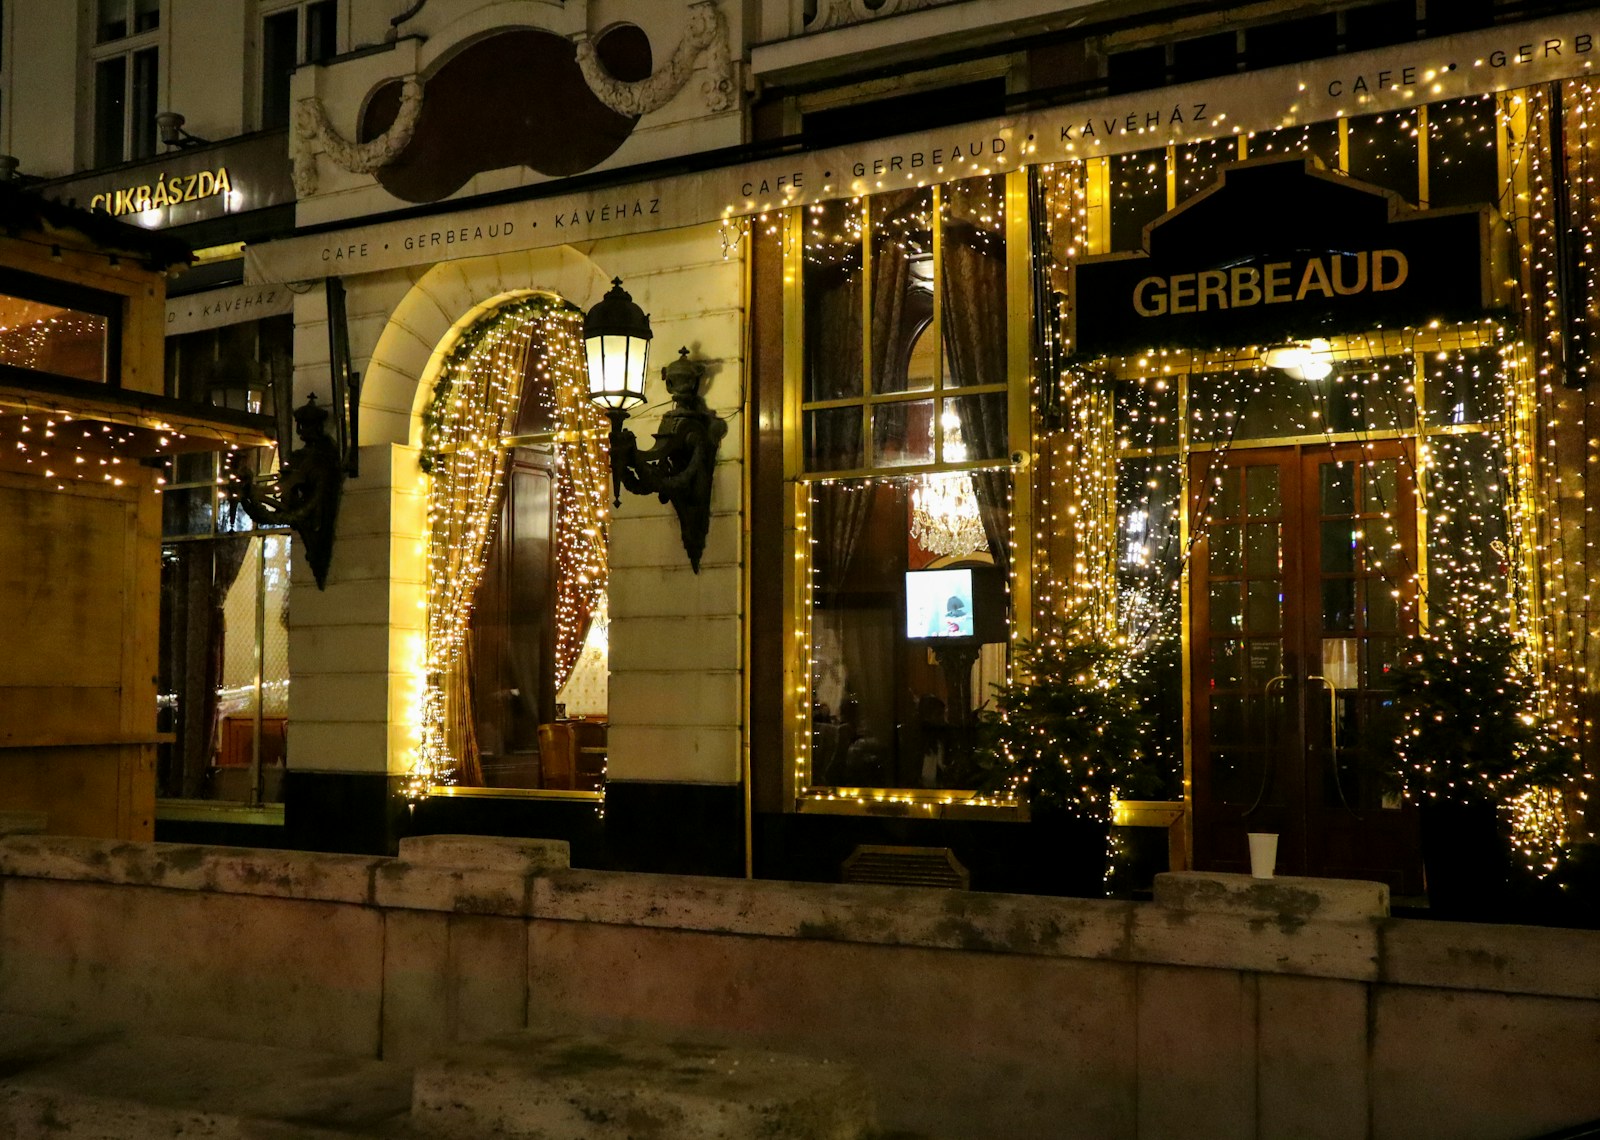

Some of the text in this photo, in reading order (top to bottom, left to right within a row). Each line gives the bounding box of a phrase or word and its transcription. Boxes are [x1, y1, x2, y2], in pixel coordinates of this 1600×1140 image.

[1328, 34, 1593, 97] CAFE GERB
[741, 104, 1208, 198] CAFE GERBEAUD KÁVÉHÁZ
[90, 167, 232, 216] CUKRÁSZDA
[321, 199, 661, 263] CAFE GERBEAUD KÁVÉHÁZ
[1132, 249, 1409, 318] GERBEAUD
